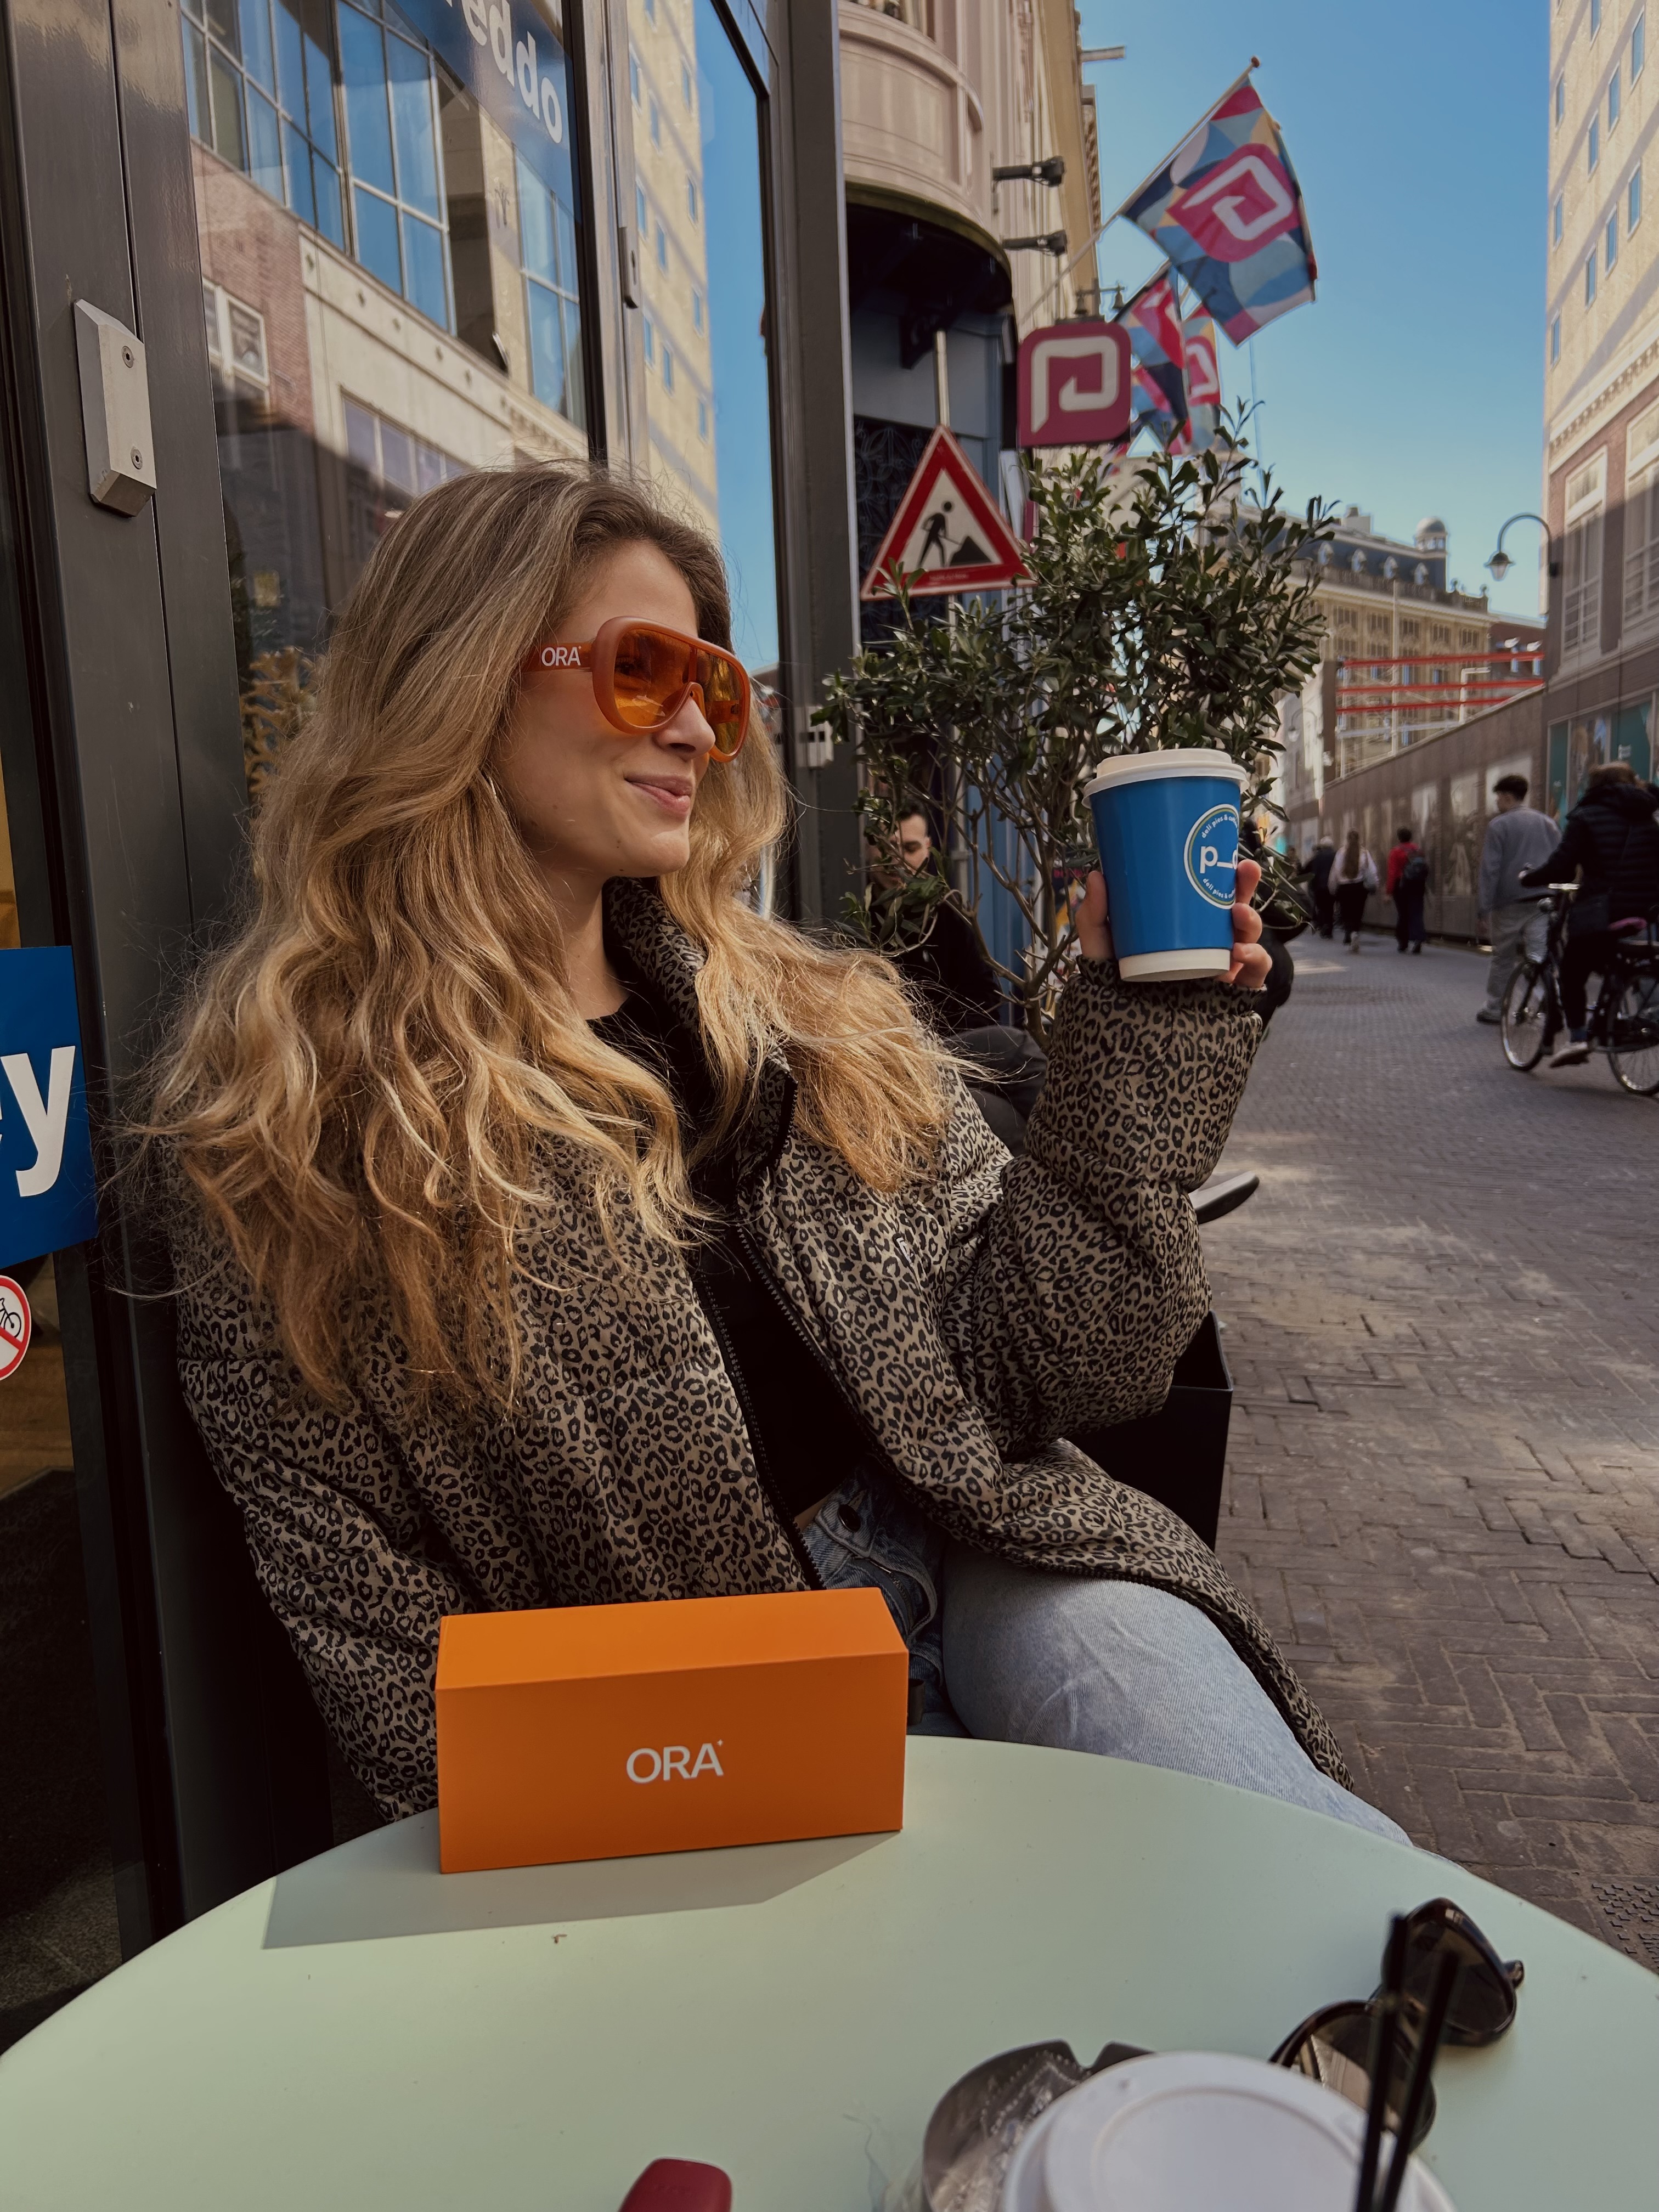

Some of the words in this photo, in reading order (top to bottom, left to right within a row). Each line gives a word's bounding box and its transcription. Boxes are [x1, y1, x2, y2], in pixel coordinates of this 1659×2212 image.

[445, 0, 562, 143] eddo
[541, 646, 582, 667] ORA
[1201, 823, 1212, 838] deli
[1212, 816, 1223, 827] pies
[1203, 878, 1214, 890] deli
[0, 1045, 76, 1198] y
[626, 1742, 724, 1784] ORA
